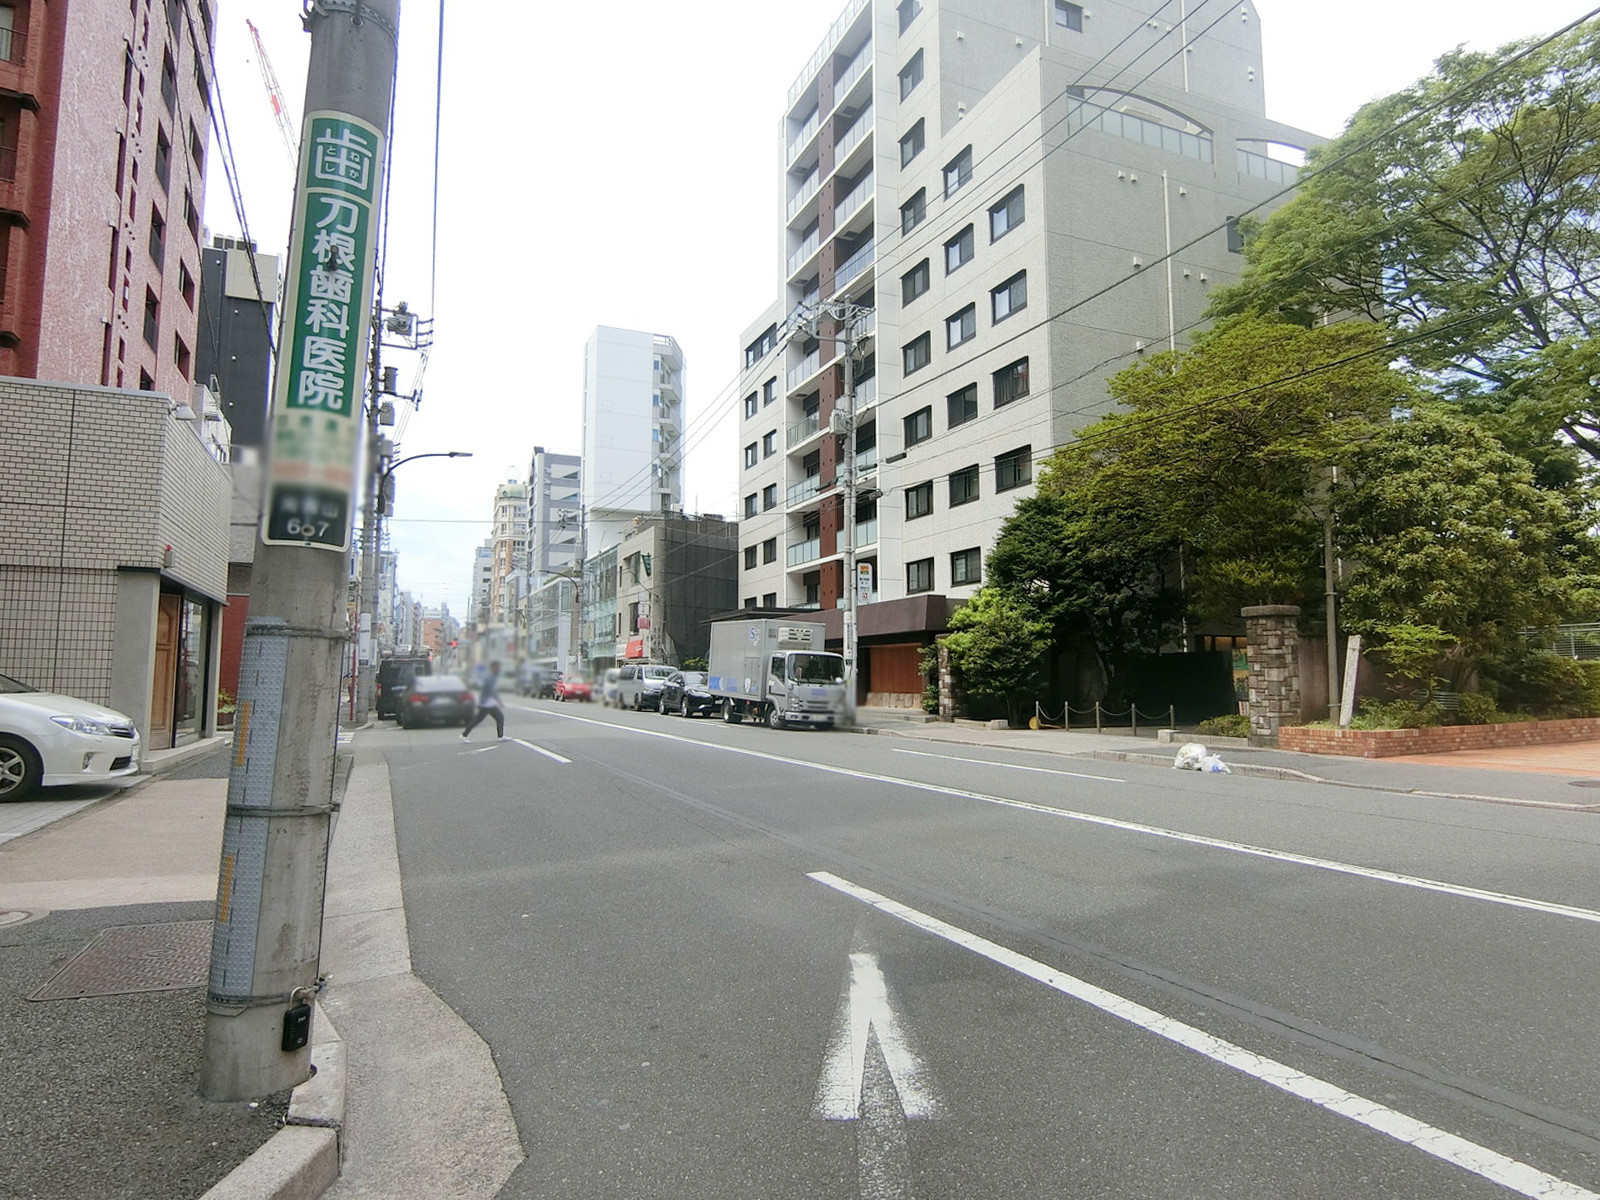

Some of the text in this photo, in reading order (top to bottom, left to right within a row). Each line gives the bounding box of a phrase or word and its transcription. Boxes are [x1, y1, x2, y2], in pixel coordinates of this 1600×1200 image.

[315, 128, 372, 190] 歯
[298, 197, 359, 410] 刀根歯科医院
